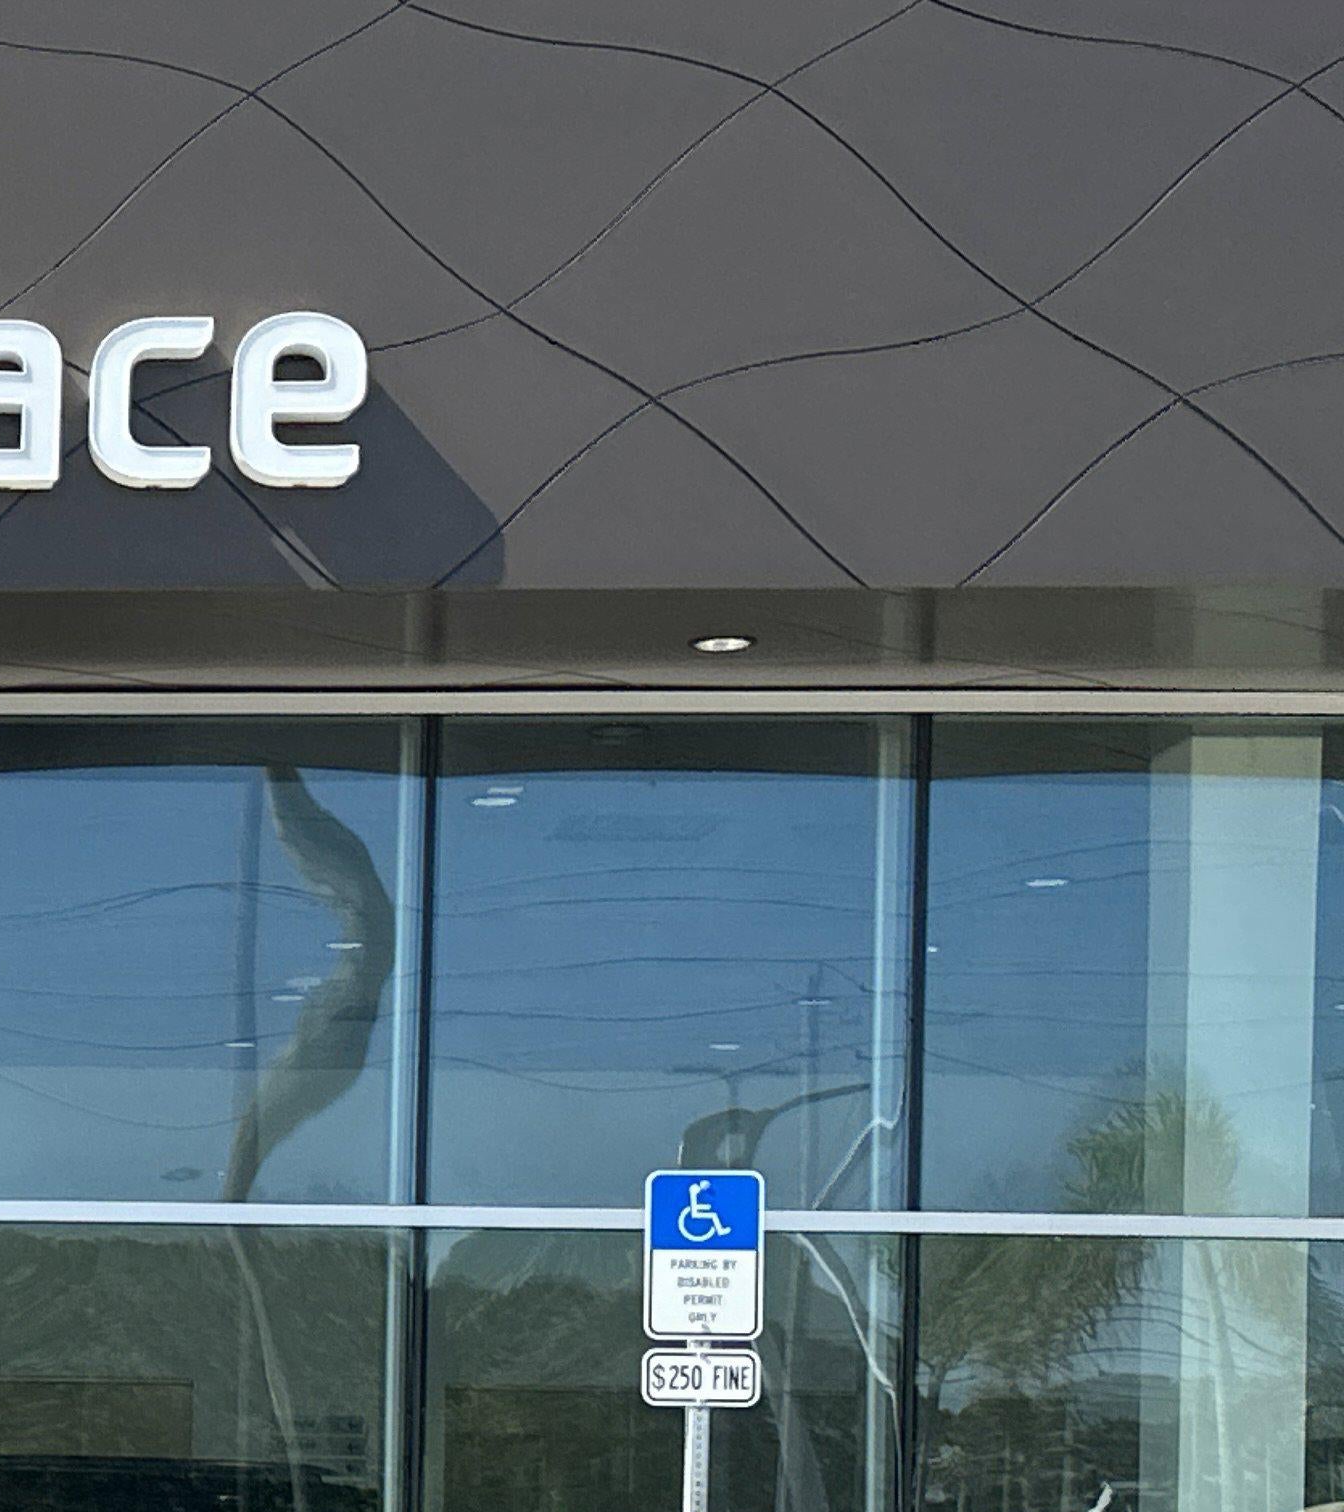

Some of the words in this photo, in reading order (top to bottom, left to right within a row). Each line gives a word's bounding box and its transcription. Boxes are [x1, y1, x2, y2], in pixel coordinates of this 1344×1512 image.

[670, 1258, 717, 1270] PARKING
[723, 1259, 737, 1270] BY
[677, 1276, 730, 1288] DISABLED
[683, 1294, 723, 1306] PERMIT
[652, 1363, 702, 1392] $250
[712, 1364, 750, 1391] FINE
